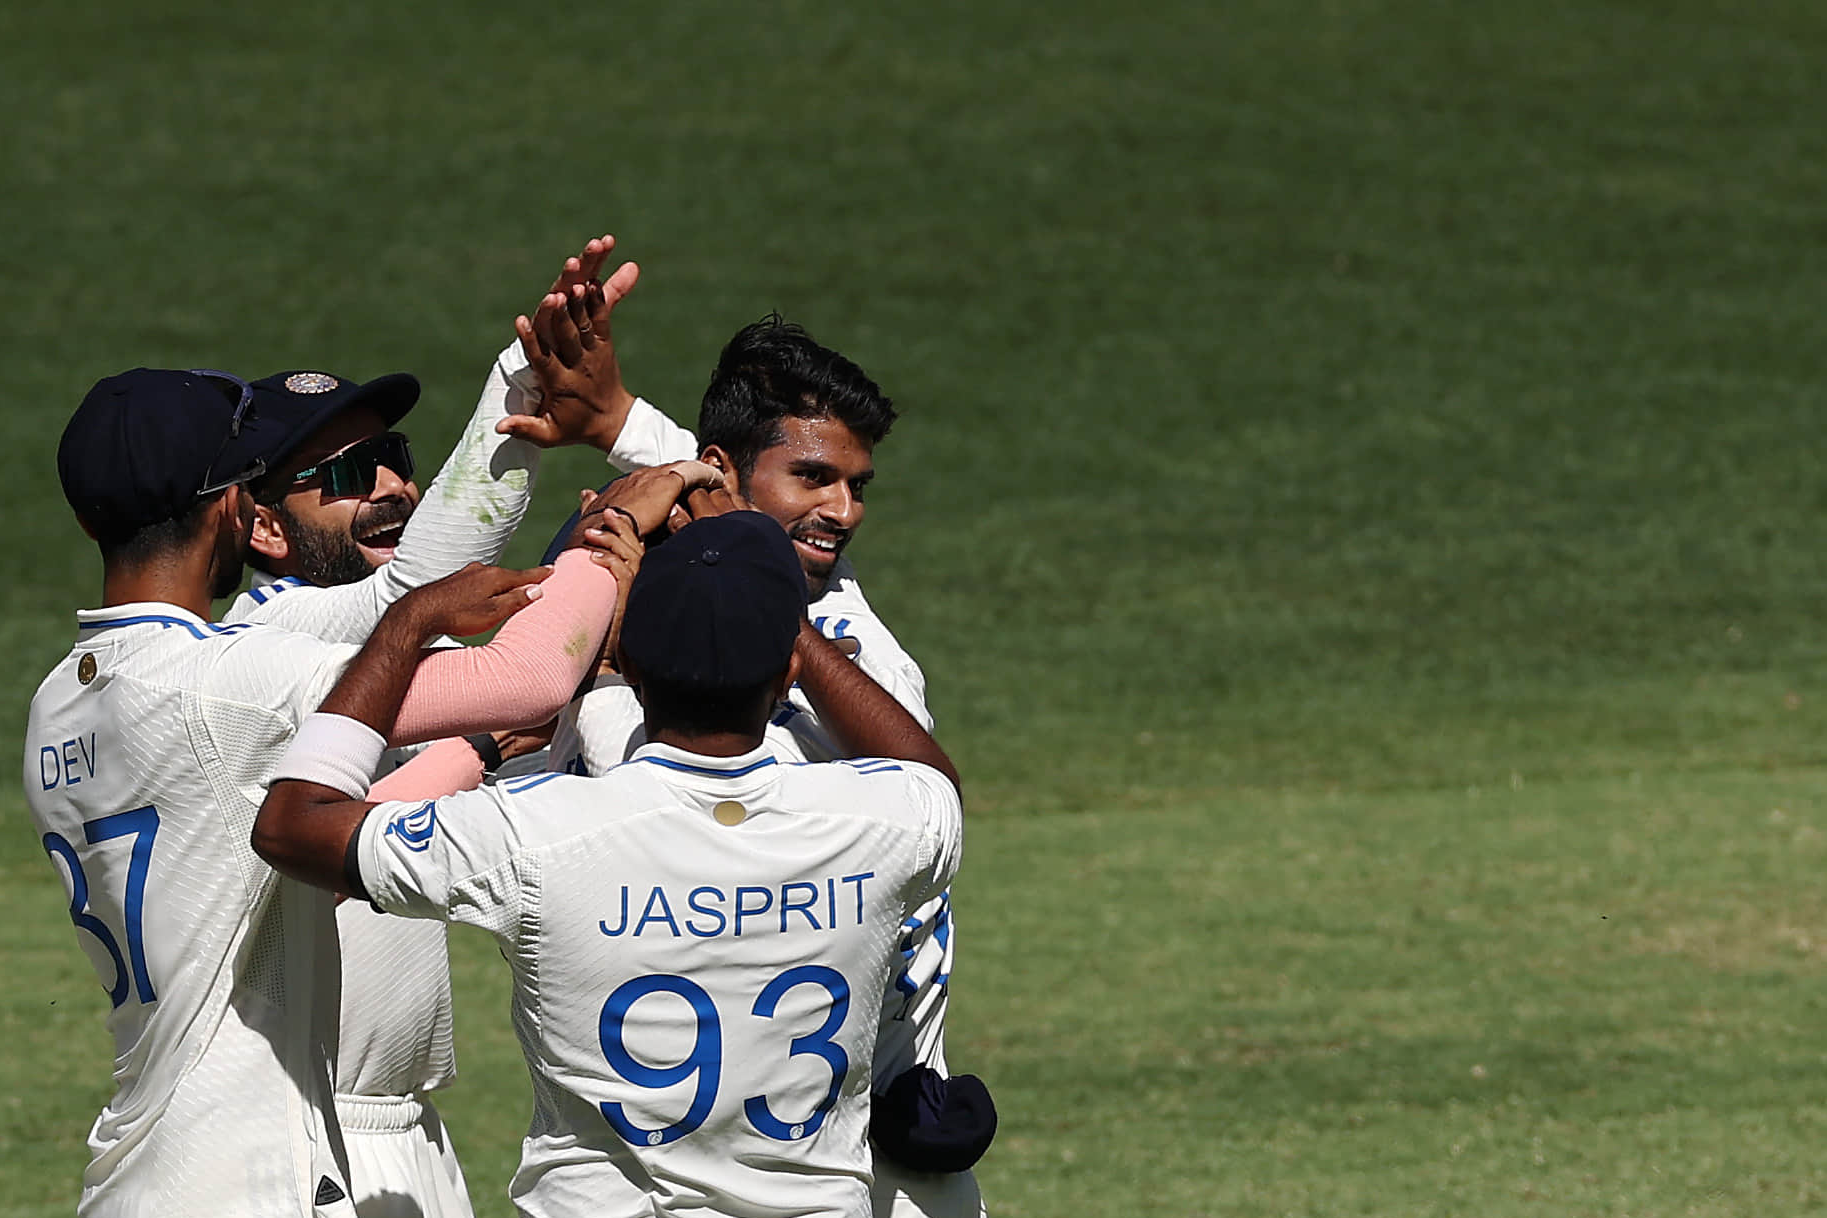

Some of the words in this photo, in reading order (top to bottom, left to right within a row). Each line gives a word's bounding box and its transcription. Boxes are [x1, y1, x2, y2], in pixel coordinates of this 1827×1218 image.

[40, 732, 96, 791] DEV
[599, 872, 875, 938] JASPRIT
[598, 964, 851, 1147] 93
